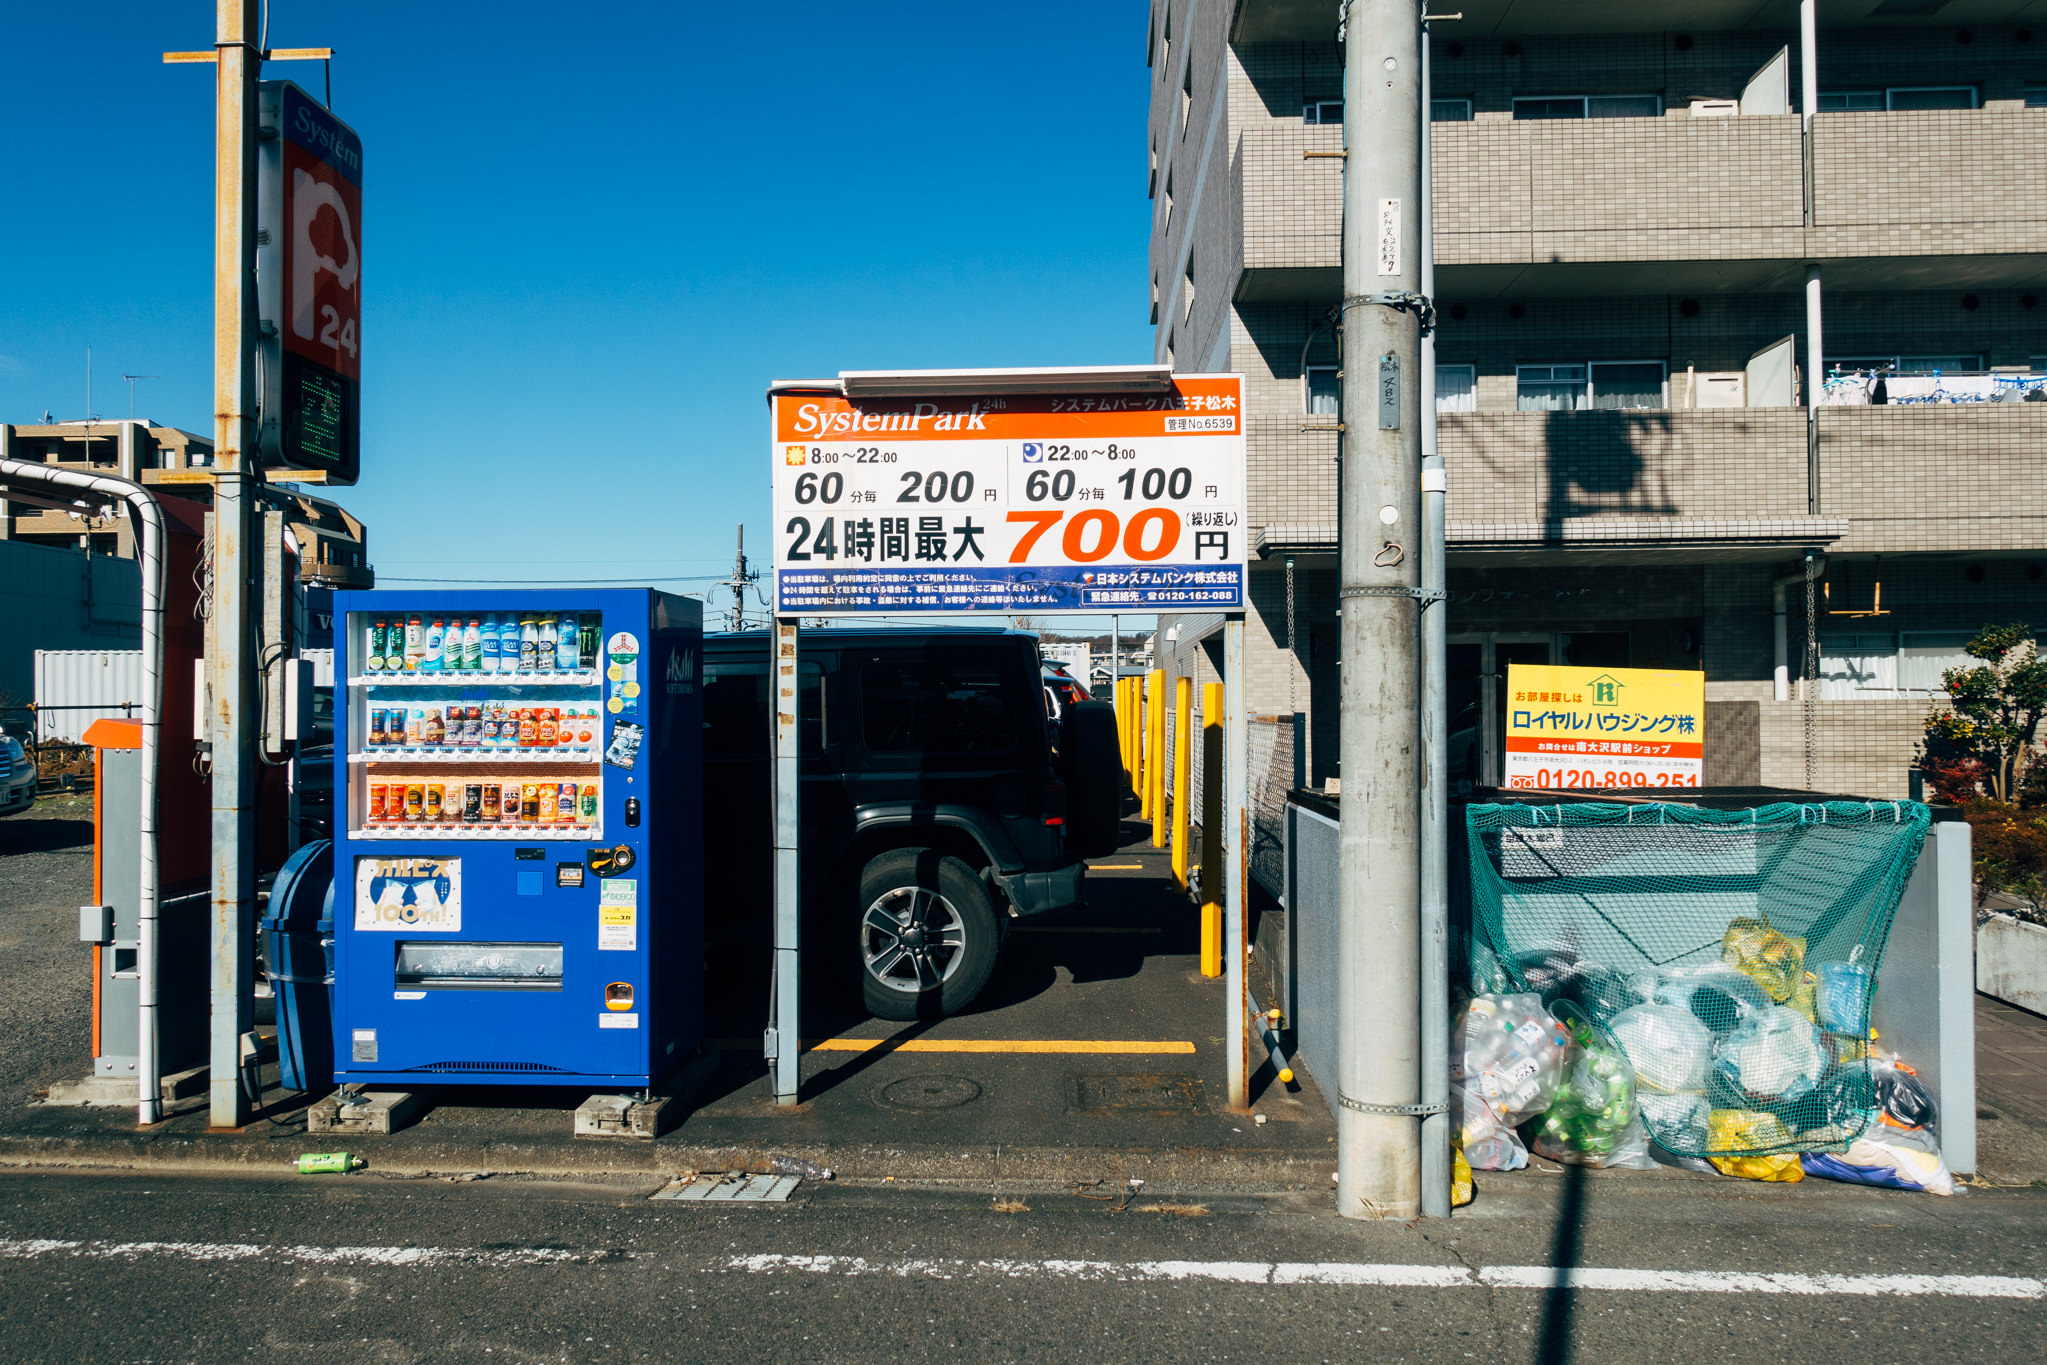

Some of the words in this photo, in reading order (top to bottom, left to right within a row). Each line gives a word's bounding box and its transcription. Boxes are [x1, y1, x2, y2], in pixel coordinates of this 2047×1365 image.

[295, 106, 359, 171] System
[320, 304, 358, 360] 24
[1051, 395, 1238, 413] システムパーク八王子松木
[301, 376, 340, 461] 空
[794, 400, 988, 441] SystemPark
[786, 515, 986, 563] 24時間最大
[1096, 571, 1239, 585] 日本システムバンク株式会社
[1090, 591, 1140, 603] 緊急連絡先
[666, 645, 694, 682] Asahi
[1515, 691, 1583, 704] お部屋探しは
[1537, 768, 1697, 788] 0120-899-251
[375, 859, 449, 878] カルピス
